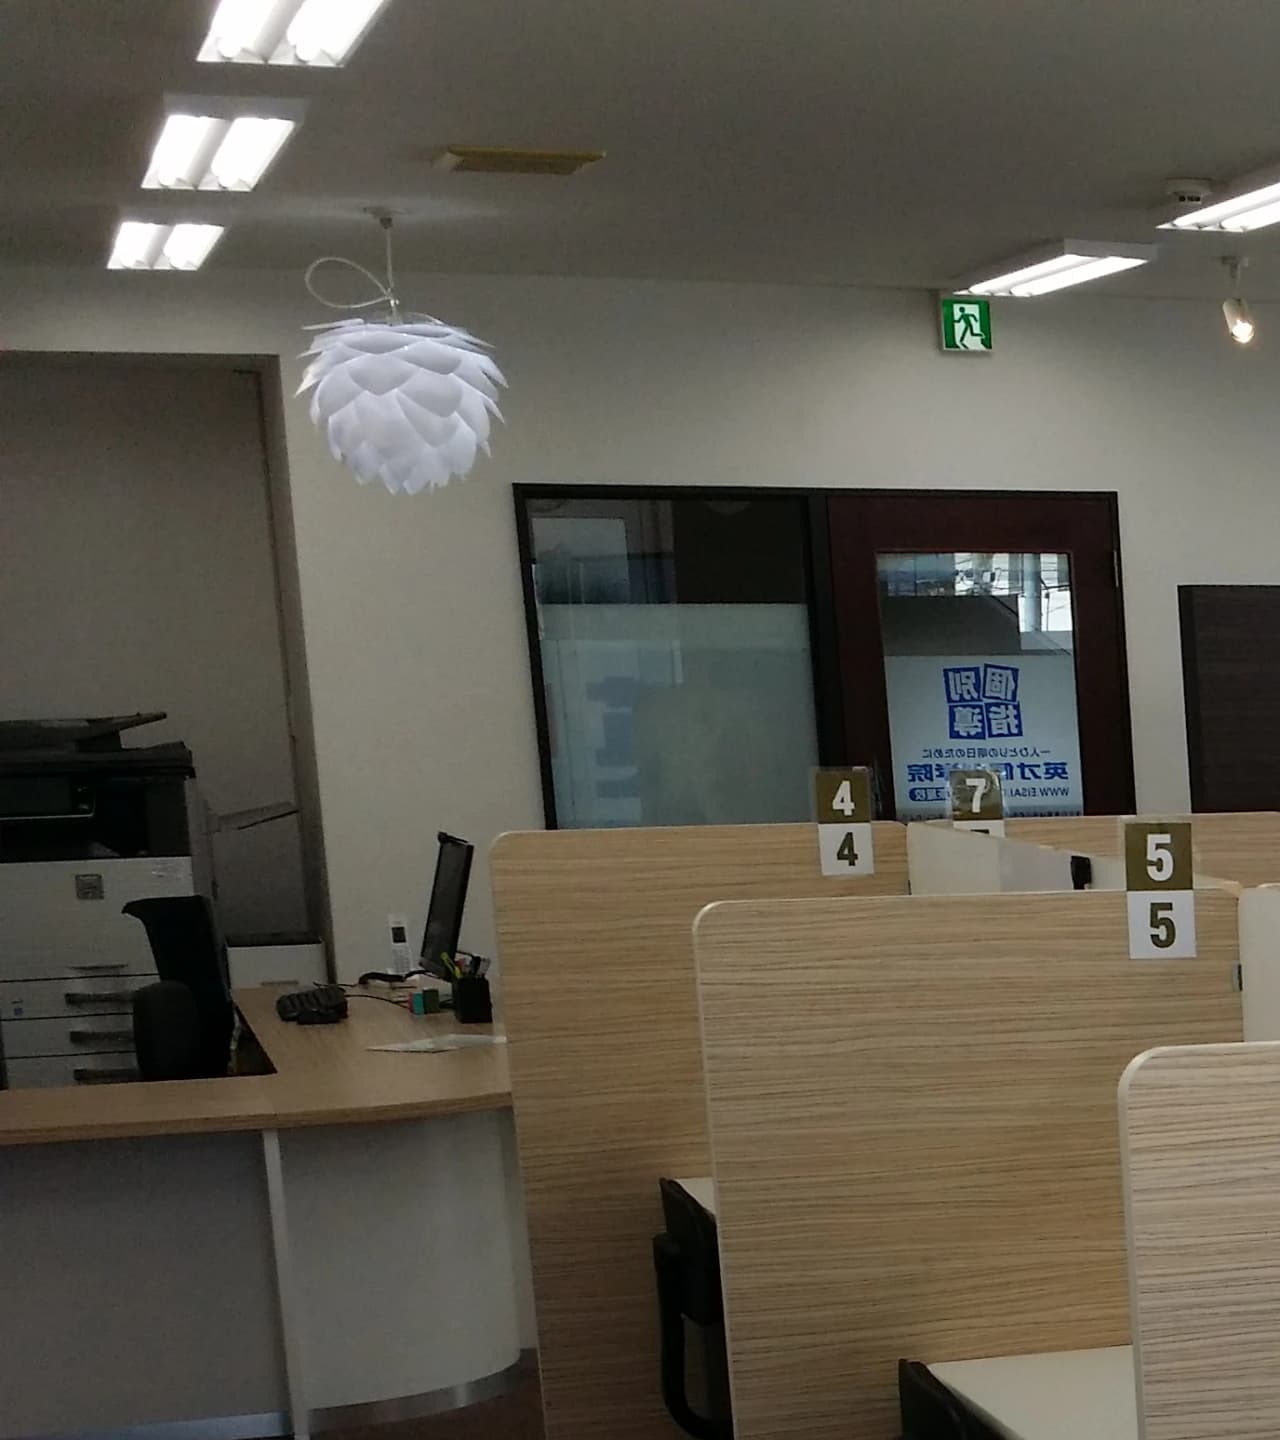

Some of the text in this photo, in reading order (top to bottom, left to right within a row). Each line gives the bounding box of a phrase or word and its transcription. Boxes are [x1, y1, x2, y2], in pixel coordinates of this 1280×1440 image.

[832, 780, 855, 816] 4
[965, 777, 986, 813] 7
[836, 831, 858, 867] 4
[1146, 833, 1174, 881] 5
[1150, 902, 1176, 948] 5
